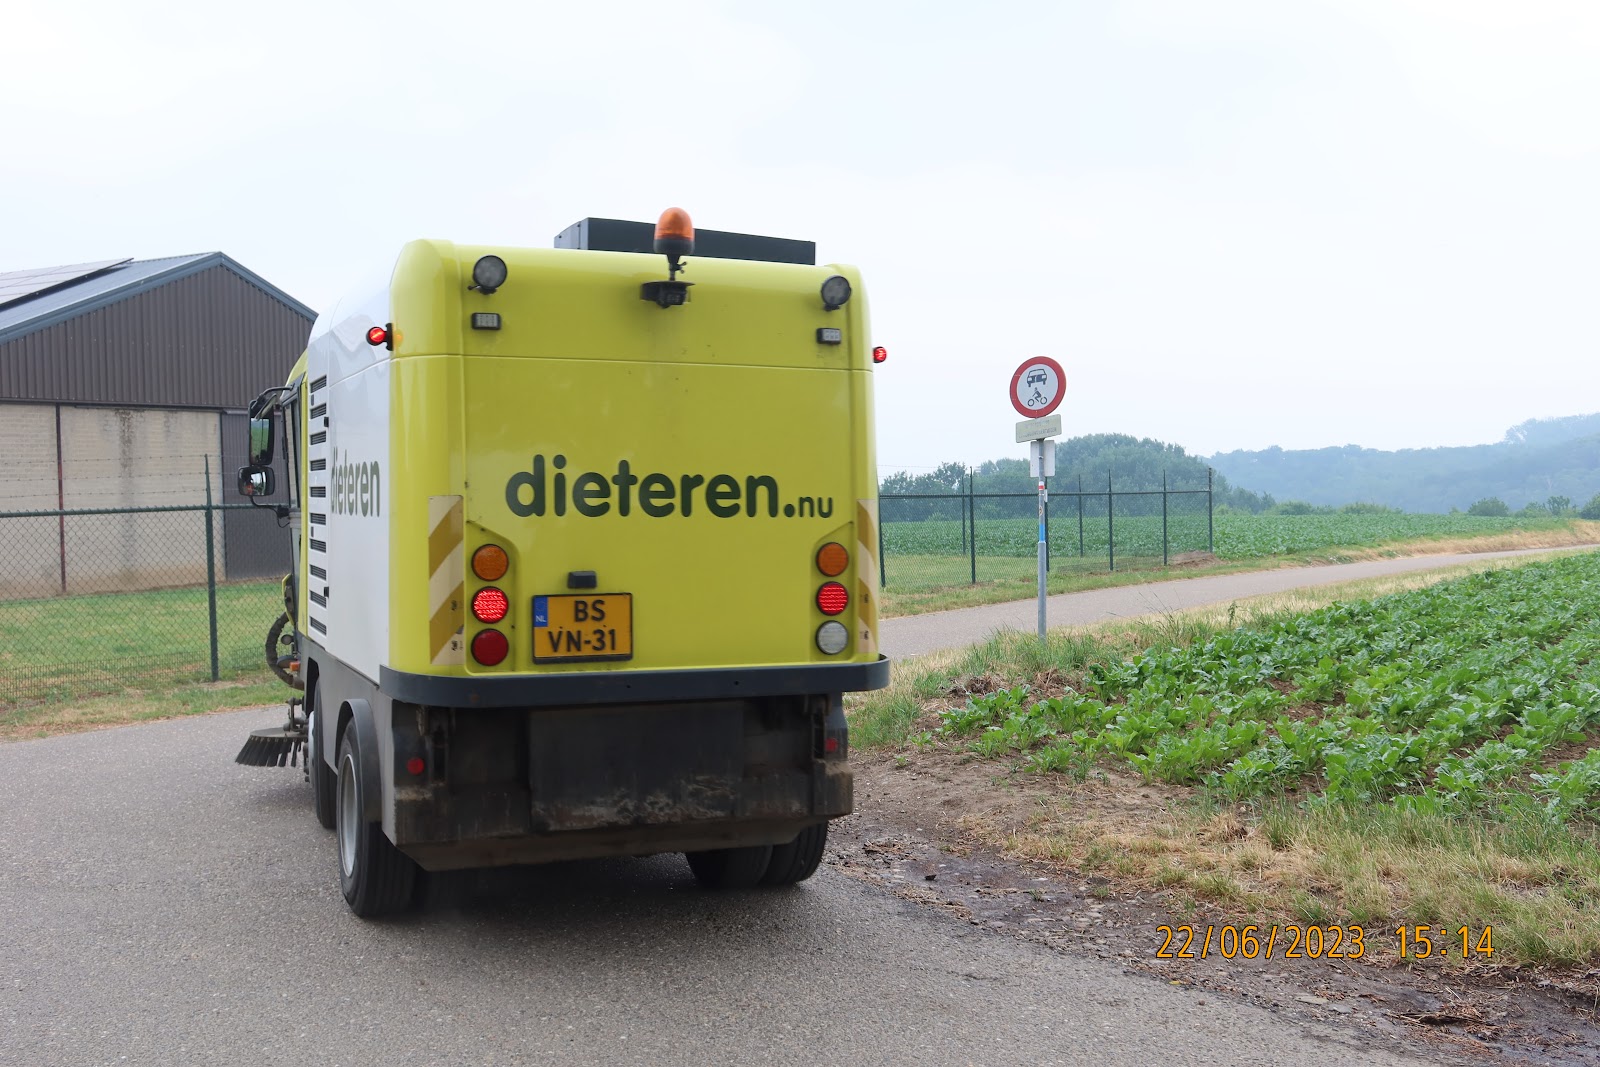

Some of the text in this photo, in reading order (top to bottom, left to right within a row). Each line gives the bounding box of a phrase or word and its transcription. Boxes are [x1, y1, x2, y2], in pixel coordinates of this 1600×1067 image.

[331, 446, 380, 518] dieteren
[505, 453, 833, 518] dieteren.nu
[535, 614, 547, 623] NL
[574, 599, 606, 622] BS
[548, 628, 616, 653] VN-31
